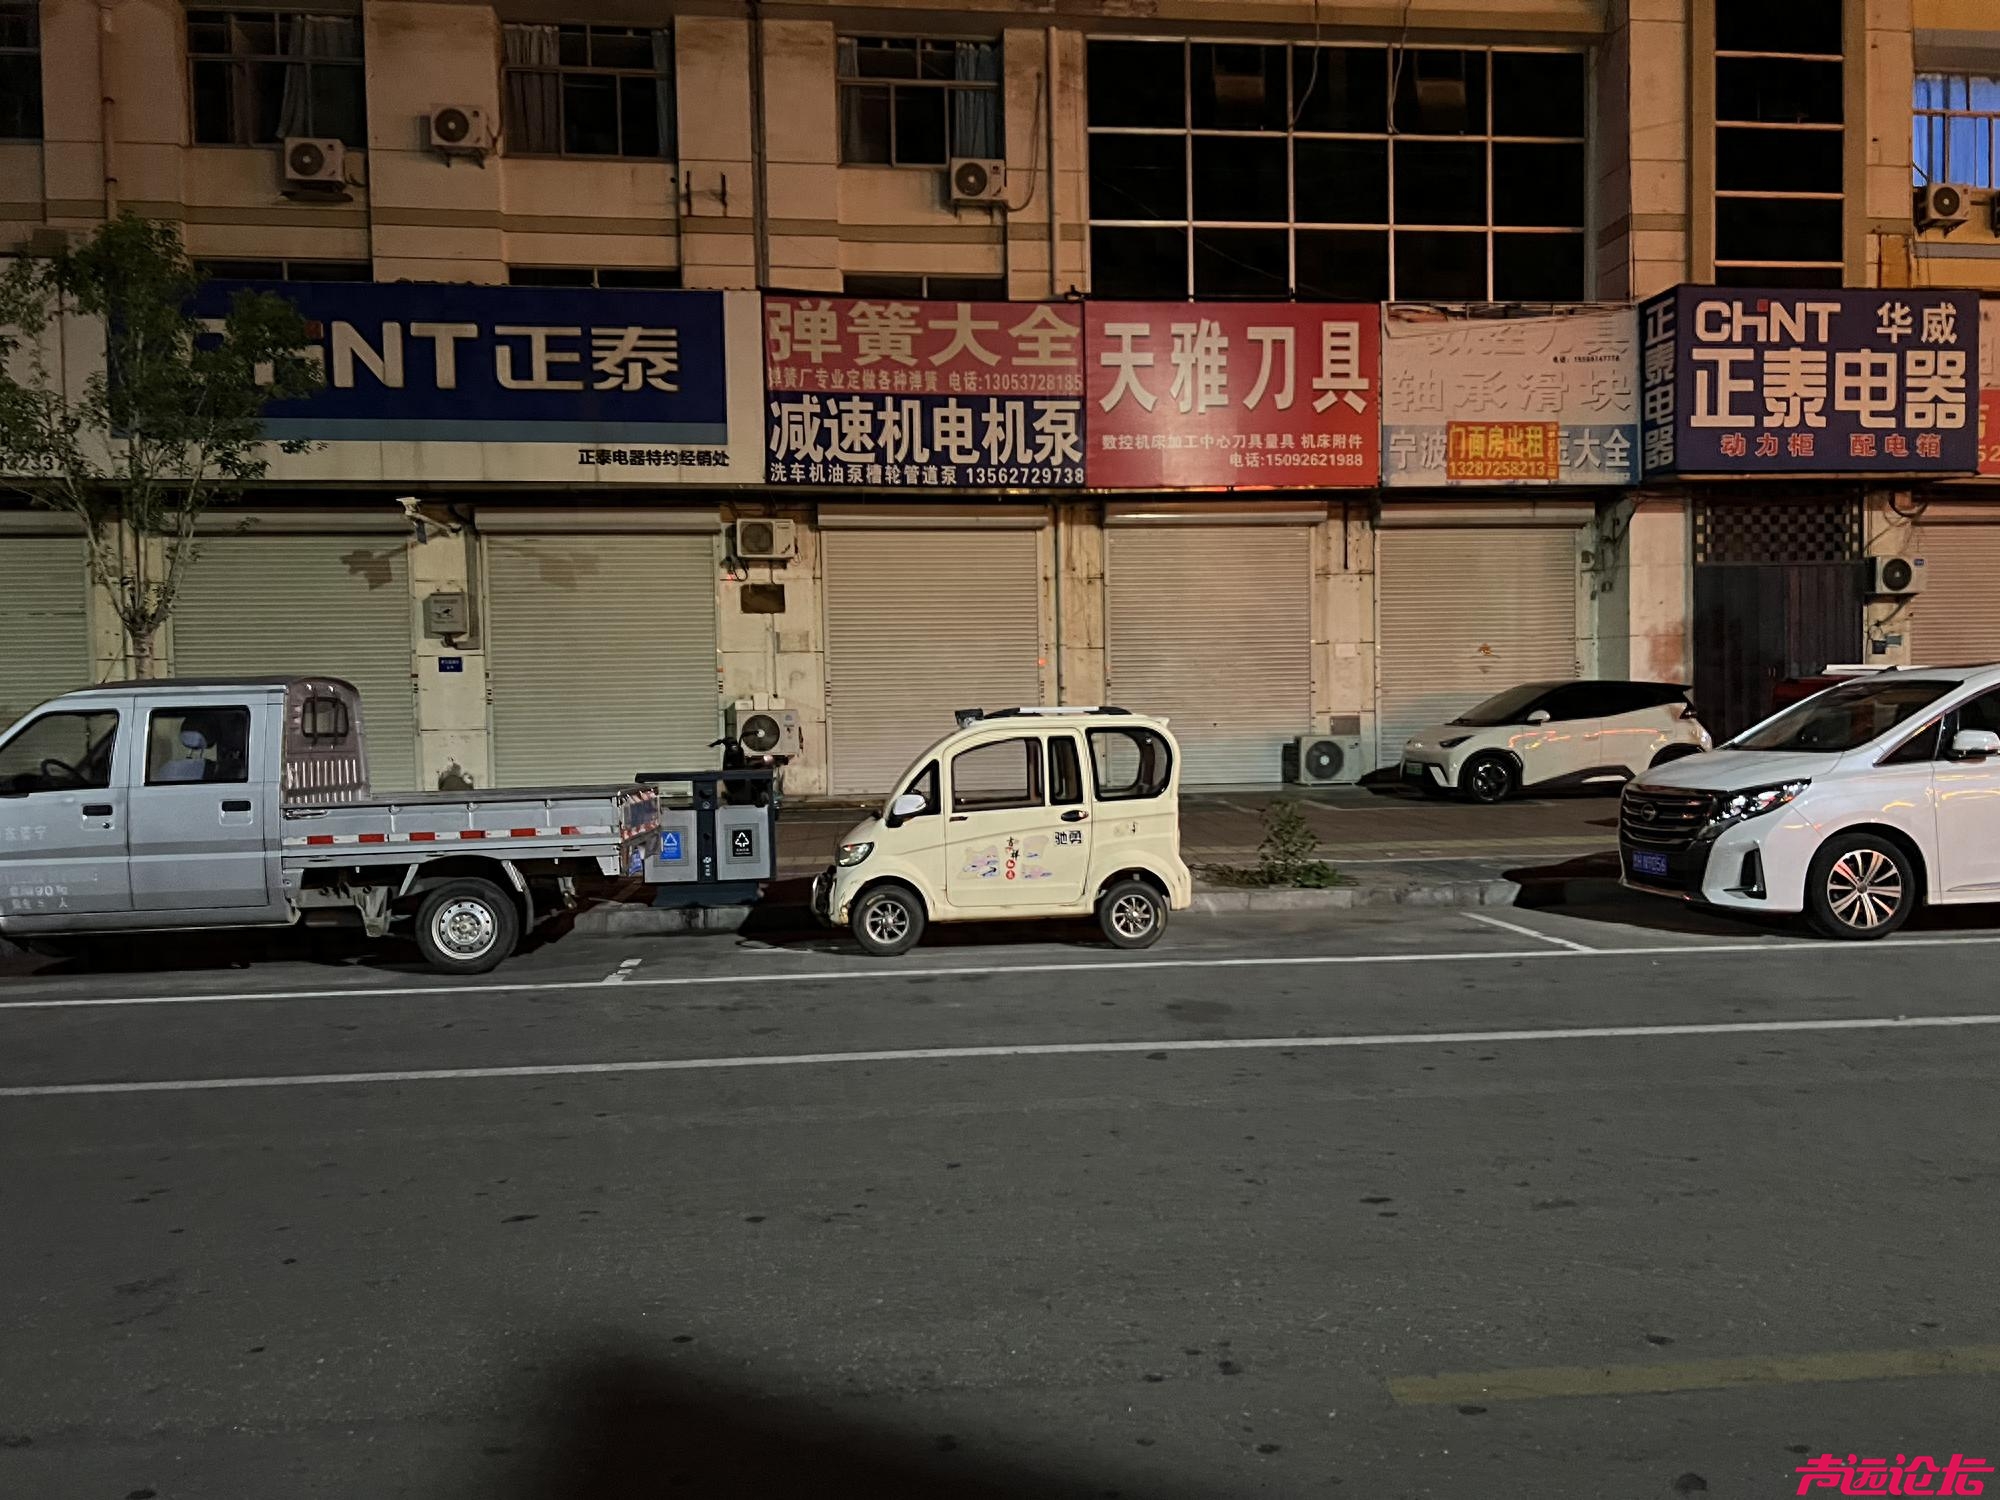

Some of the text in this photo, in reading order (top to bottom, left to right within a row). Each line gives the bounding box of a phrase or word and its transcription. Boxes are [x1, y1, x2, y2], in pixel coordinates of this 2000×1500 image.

[766, 299, 1081, 367] 弹簧大全
[1876, 302, 1957, 344] 华威
[494, 325, 680, 391] 正泰
[1099, 318, 1370, 415] 天雅刀具
[1391, 370, 1632, 413] 轴承滑块
[1645, 297, 1676, 470] 正泰电器
[1691, 348, 1967, 429] 正泰电器
[769, 395, 1083, 466] 减速机电机泵
[1102, 434, 1363, 450] 数控机床加工中心刀具量具 机床附件
[1449, 424, 1544, 459] 门面房出租
[1720, 433, 1942, 458] 动力柜 配电箱
[578, 449, 730, 466] 正泰电器特约经销处
[966, 466, 1084, 484] 13562729738
[1229, 452, 1363, 467] 电话:15092621988
